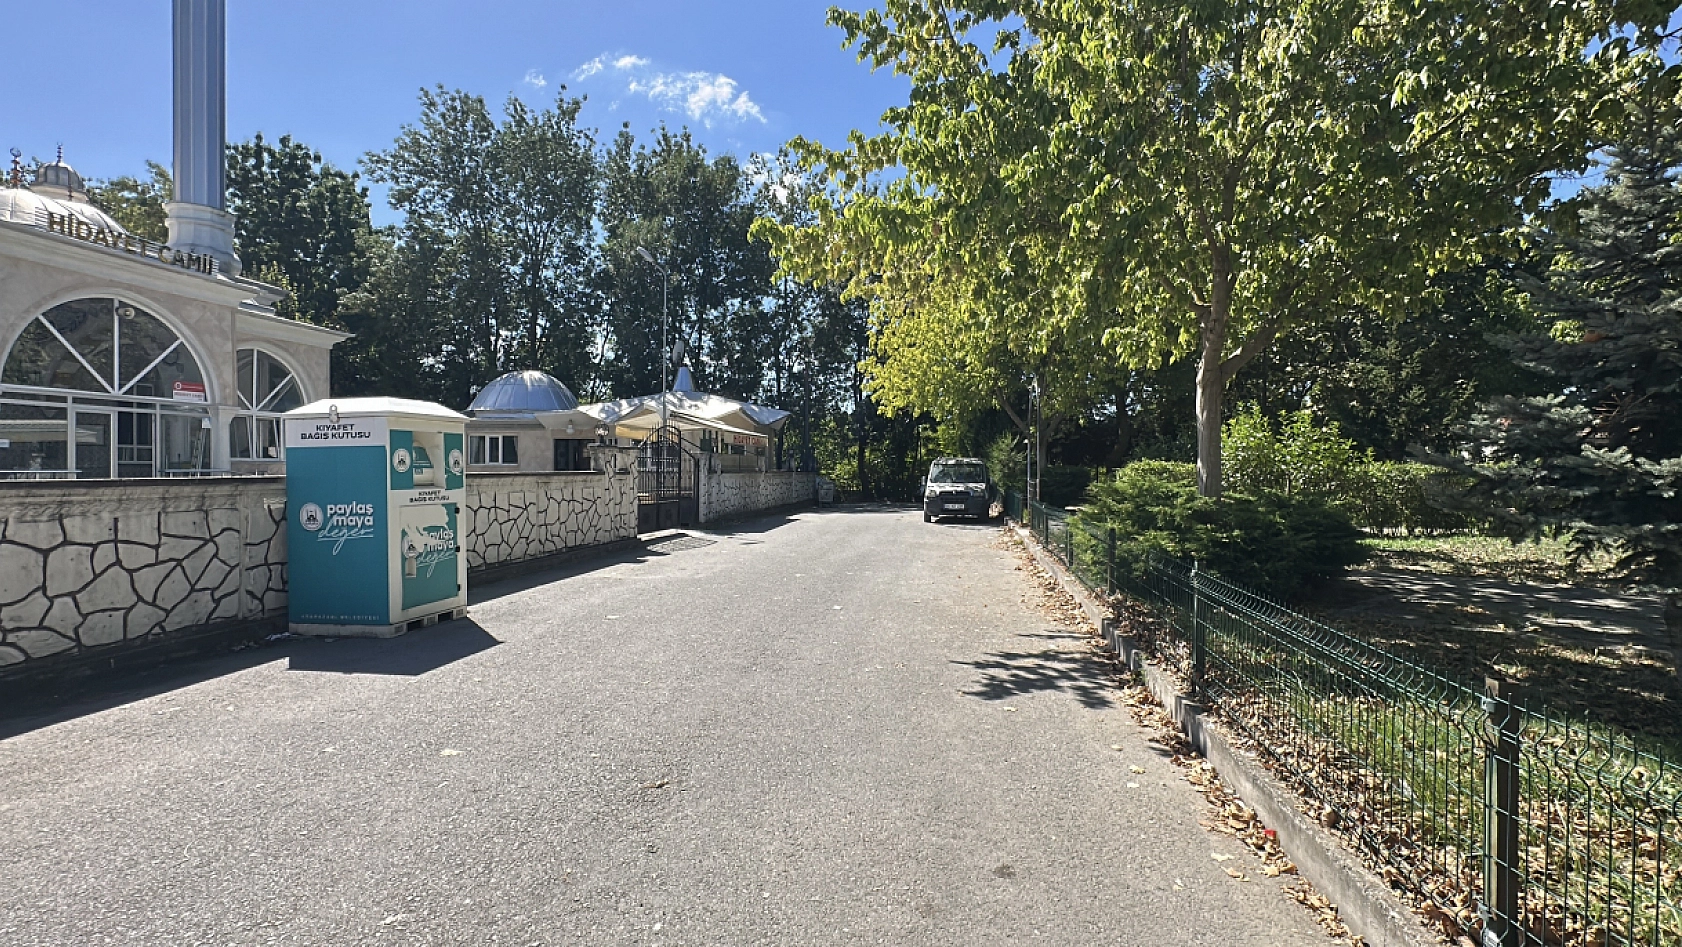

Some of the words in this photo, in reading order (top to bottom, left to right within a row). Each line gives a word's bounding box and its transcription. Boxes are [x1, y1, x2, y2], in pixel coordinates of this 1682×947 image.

[316, 424, 355, 432] KIYAFET
[331, 431, 371, 440] KUTUSU
[327, 500, 374, 518] paylaş
[332, 514, 374, 528] maya
